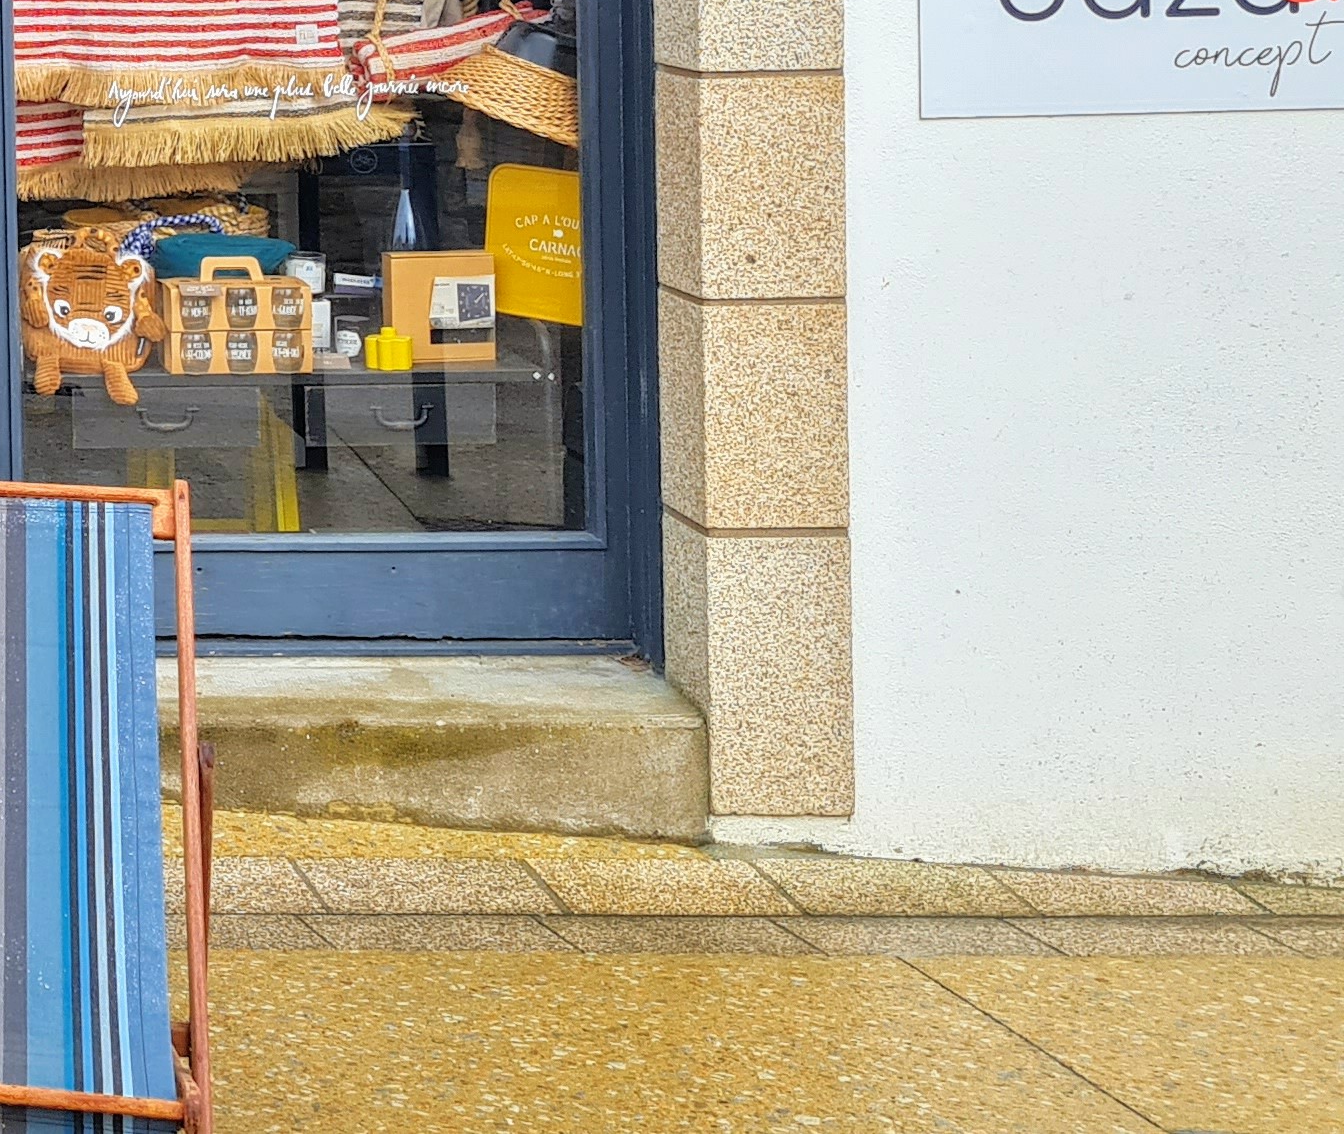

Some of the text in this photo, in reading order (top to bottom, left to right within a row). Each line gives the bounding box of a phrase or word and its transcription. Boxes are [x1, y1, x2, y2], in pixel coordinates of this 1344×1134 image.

[1174, 10, 1344, 97] concept
[206, 84, 238, 102] sera
[244, 82, 269, 98] une
[269, 75, 314, 120] plus
[323, 73, 357, 97] belle
[356, 74, 419, 121] journée
[426, 80, 470, 94] encore
[515, 214, 539, 228] CAP
[555, 215, 581, 230] L'OU
